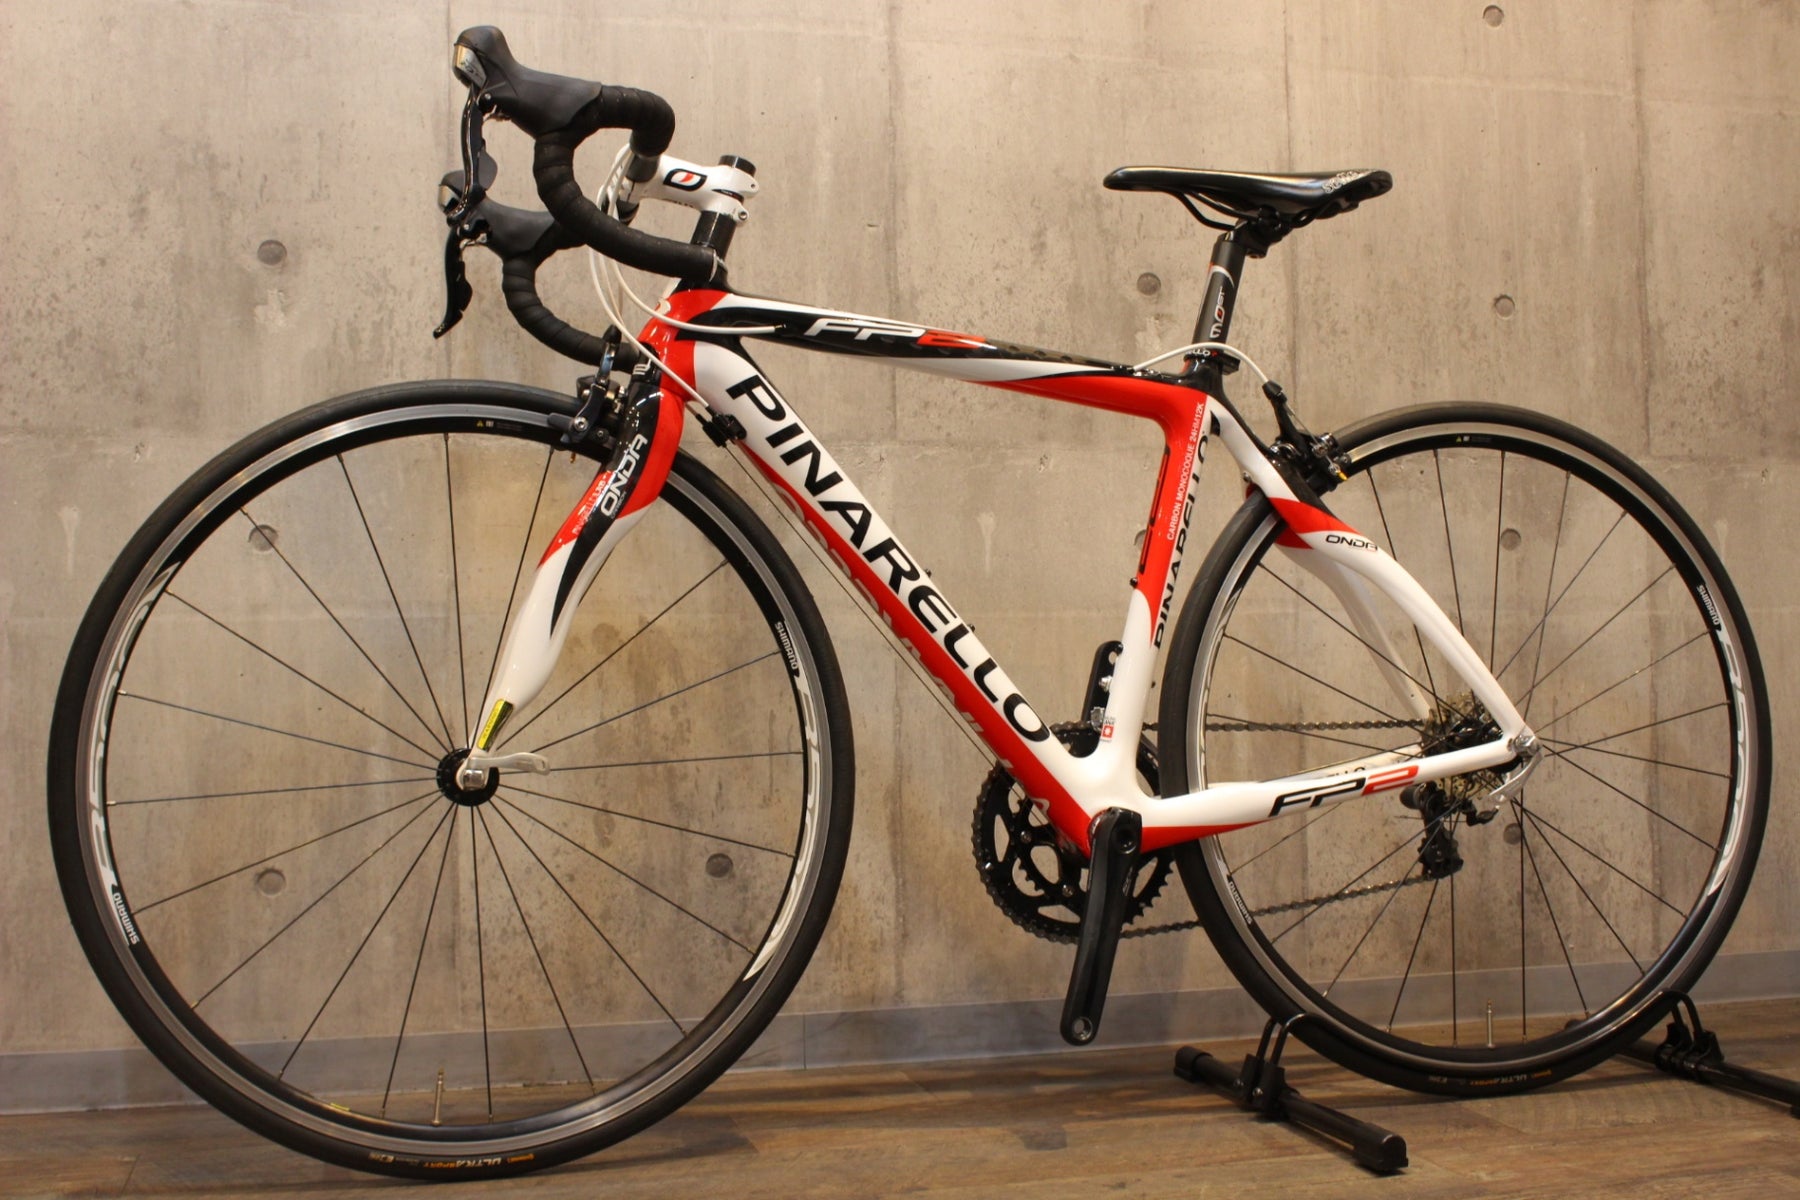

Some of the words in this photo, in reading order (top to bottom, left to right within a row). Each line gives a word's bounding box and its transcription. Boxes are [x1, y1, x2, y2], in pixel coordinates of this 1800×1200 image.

[601, 433, 648, 517] ONDA
[1167, 502, 1182, 541] CARBON
[1176, 443, 1195, 501] MONOCOQUE
[726, 374, 1050, 743] PINARELLO
[1326, 534, 1378, 551] ONDA
[1696, 584, 1720, 625] SHIMANO
[775, 621, 798, 670] SHIMANO
[1268, 765, 1419, 817] FP2
[112, 892, 140, 945] SHIMANO
